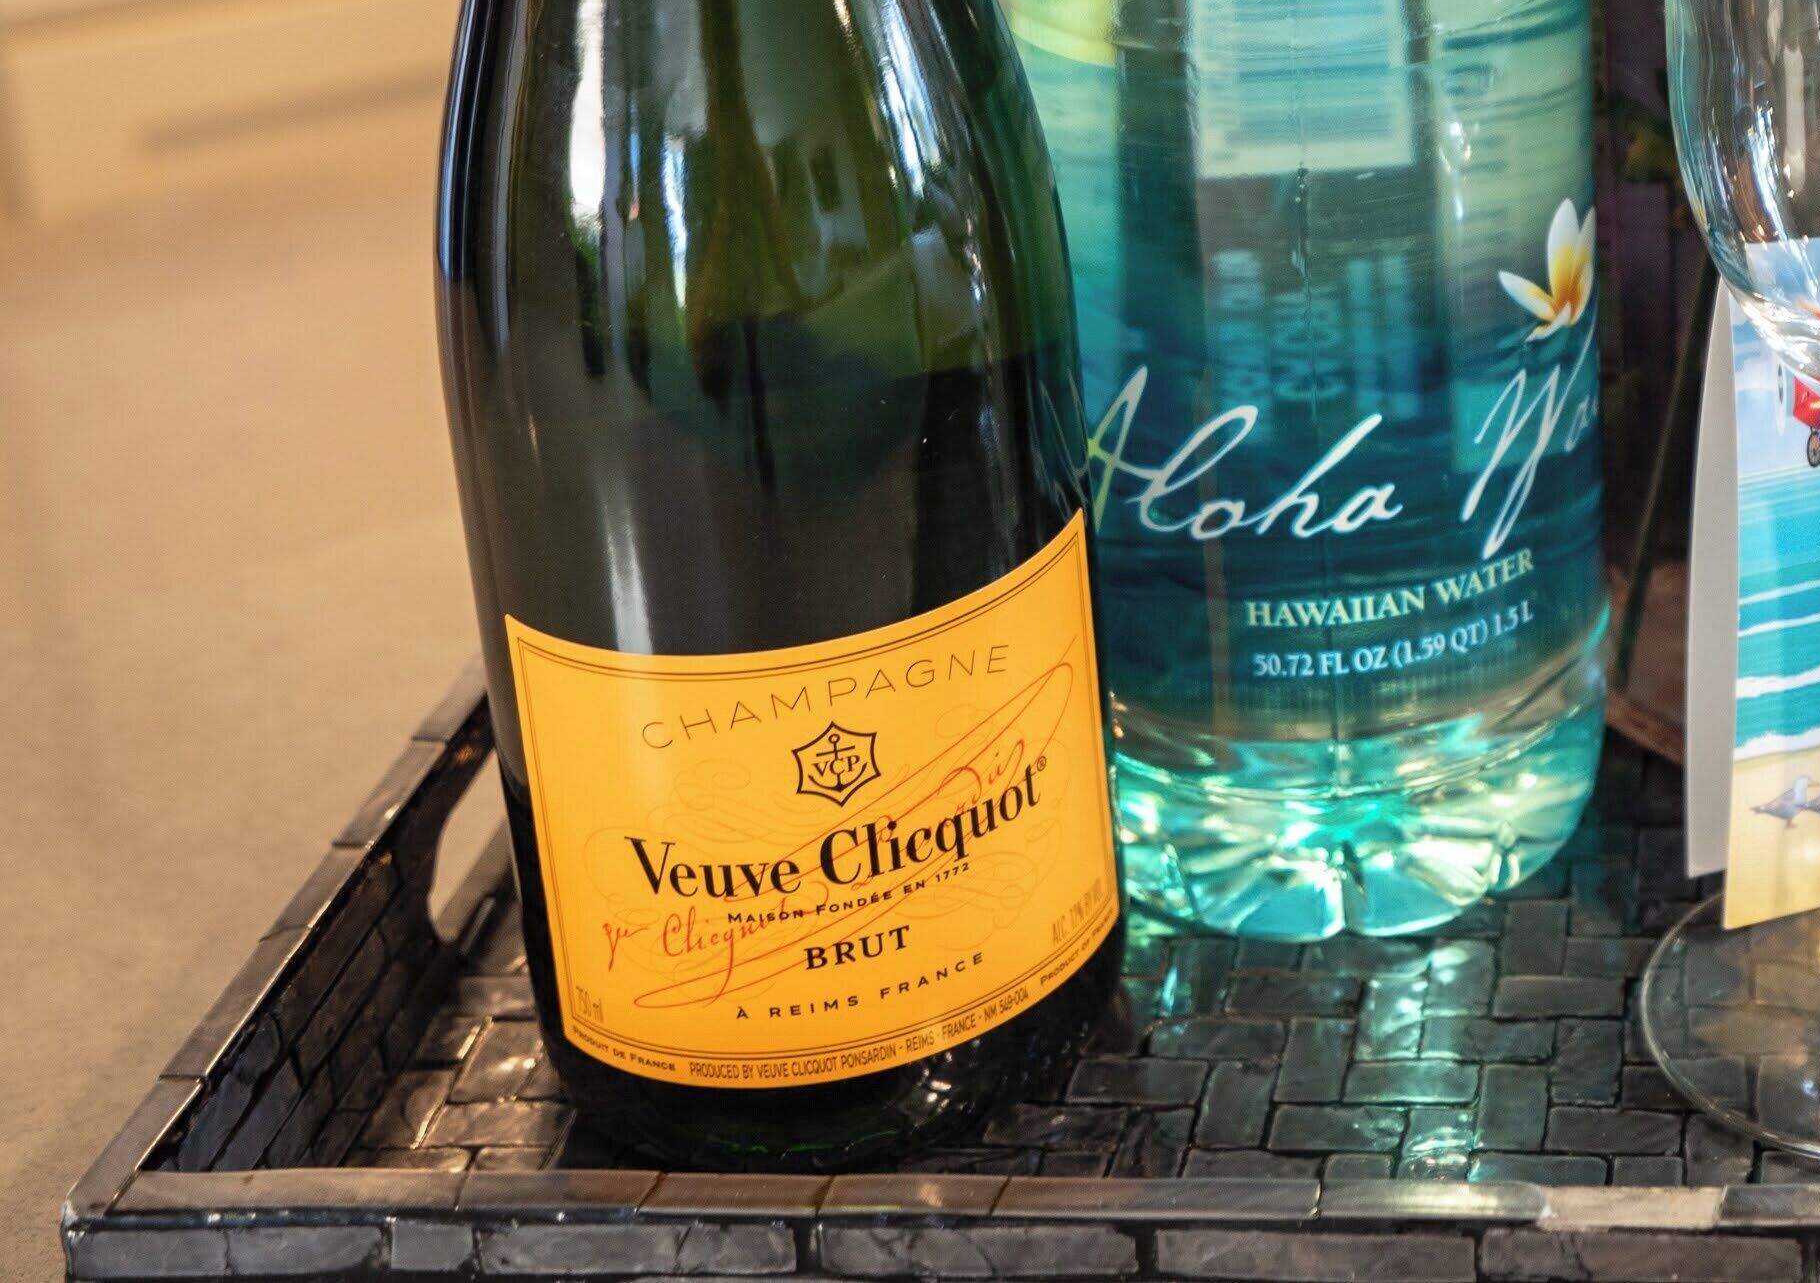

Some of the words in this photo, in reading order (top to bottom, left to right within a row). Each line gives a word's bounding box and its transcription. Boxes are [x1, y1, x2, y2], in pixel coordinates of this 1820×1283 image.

[1086, 365, 1403, 540] Aloha
[1245, 584, 1427, 628] HAWAIIAN
[1432, 548, 1535, 606] WATER
[1252, 651, 1315, 678] 50.72
[1319, 650, 1349, 676] FL
[1353, 644, 1390, 673] OZ
[1391, 632, 1447, 670] (1.59
[1450, 618, 1489, 656] QT)
[1493, 605, 1520, 639] 1.5
[641, 644, 1010, 750] CHAMPAGNE
[812, 752, 862, 780] VCP
[623, 835, 803, 900] Veuve
[903, 878, 927, 895] EN
[935, 862, 970, 883] 1772
[804, 924, 911, 970] BRUT
[768, 995, 860, 1018] REIMS
[880, 952, 983, 999] FRANCE
[629, 1051, 677, 1072] FRANCE
[689, 1061, 741, 1079] PRODUCED
[742, 1062, 755, 1080] BY
[757, 1062, 789, 1078] VEUVE
[791, 1056, 839, 1077] CLICQUOT
[840, 1042, 897, 1070] PONSARDIN
[905, 1029, 935, 1052] REIMS
[941, 1014, 977, 1038] FRANCE
